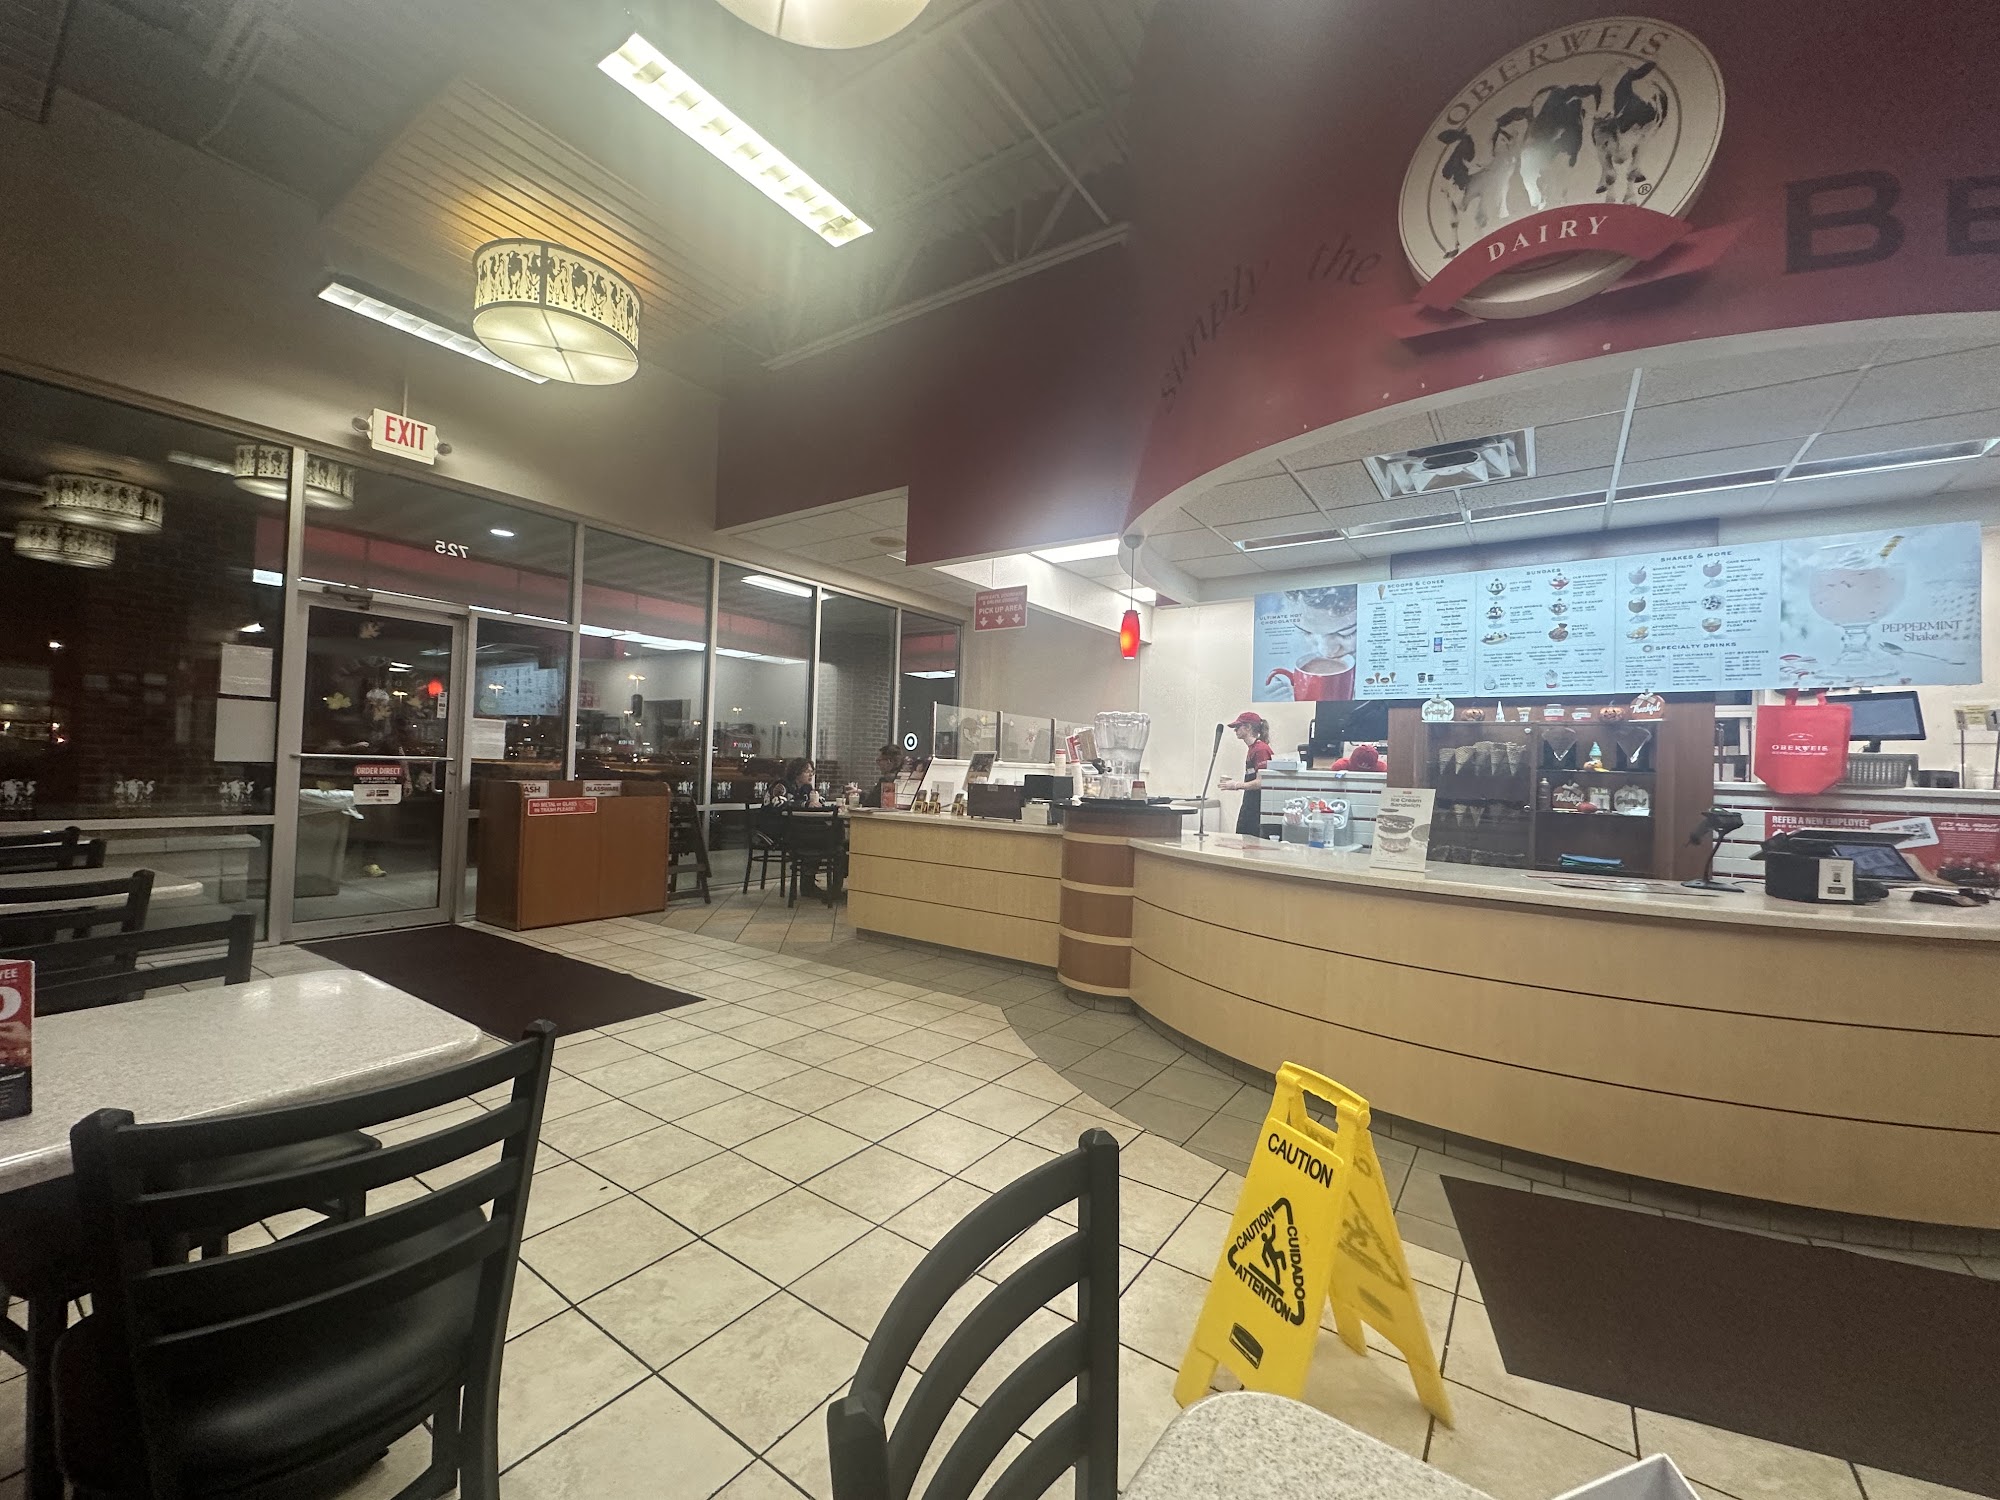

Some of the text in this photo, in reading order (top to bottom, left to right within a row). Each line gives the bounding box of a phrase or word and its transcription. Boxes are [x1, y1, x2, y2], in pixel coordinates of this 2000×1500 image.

[1446, 25, 1671, 127] OBERWEIS
[1487, 216, 1609, 262] DAIRY
[1161, 232, 1383, 415] simply the
[385, 415, 428, 451] EXIT
[1882, 619, 1962, 633] PEPPERMINT
[1904, 632, 1939, 642] Shake
[1990, 710, 1998, 724] 1
[1772, 816, 1796, 824] REFER
[1806, 817, 1823, 825] NEW
[1826, 818, 1870, 827] EMPLOYEE
[1267, 1133, 1334, 1189] CAUTION
[1236, 1206, 1274, 1250] CAUTION
[1287, 1225, 1306, 1300] CUIDADO
[1234, 1264, 1292, 1322] ATTENTION
